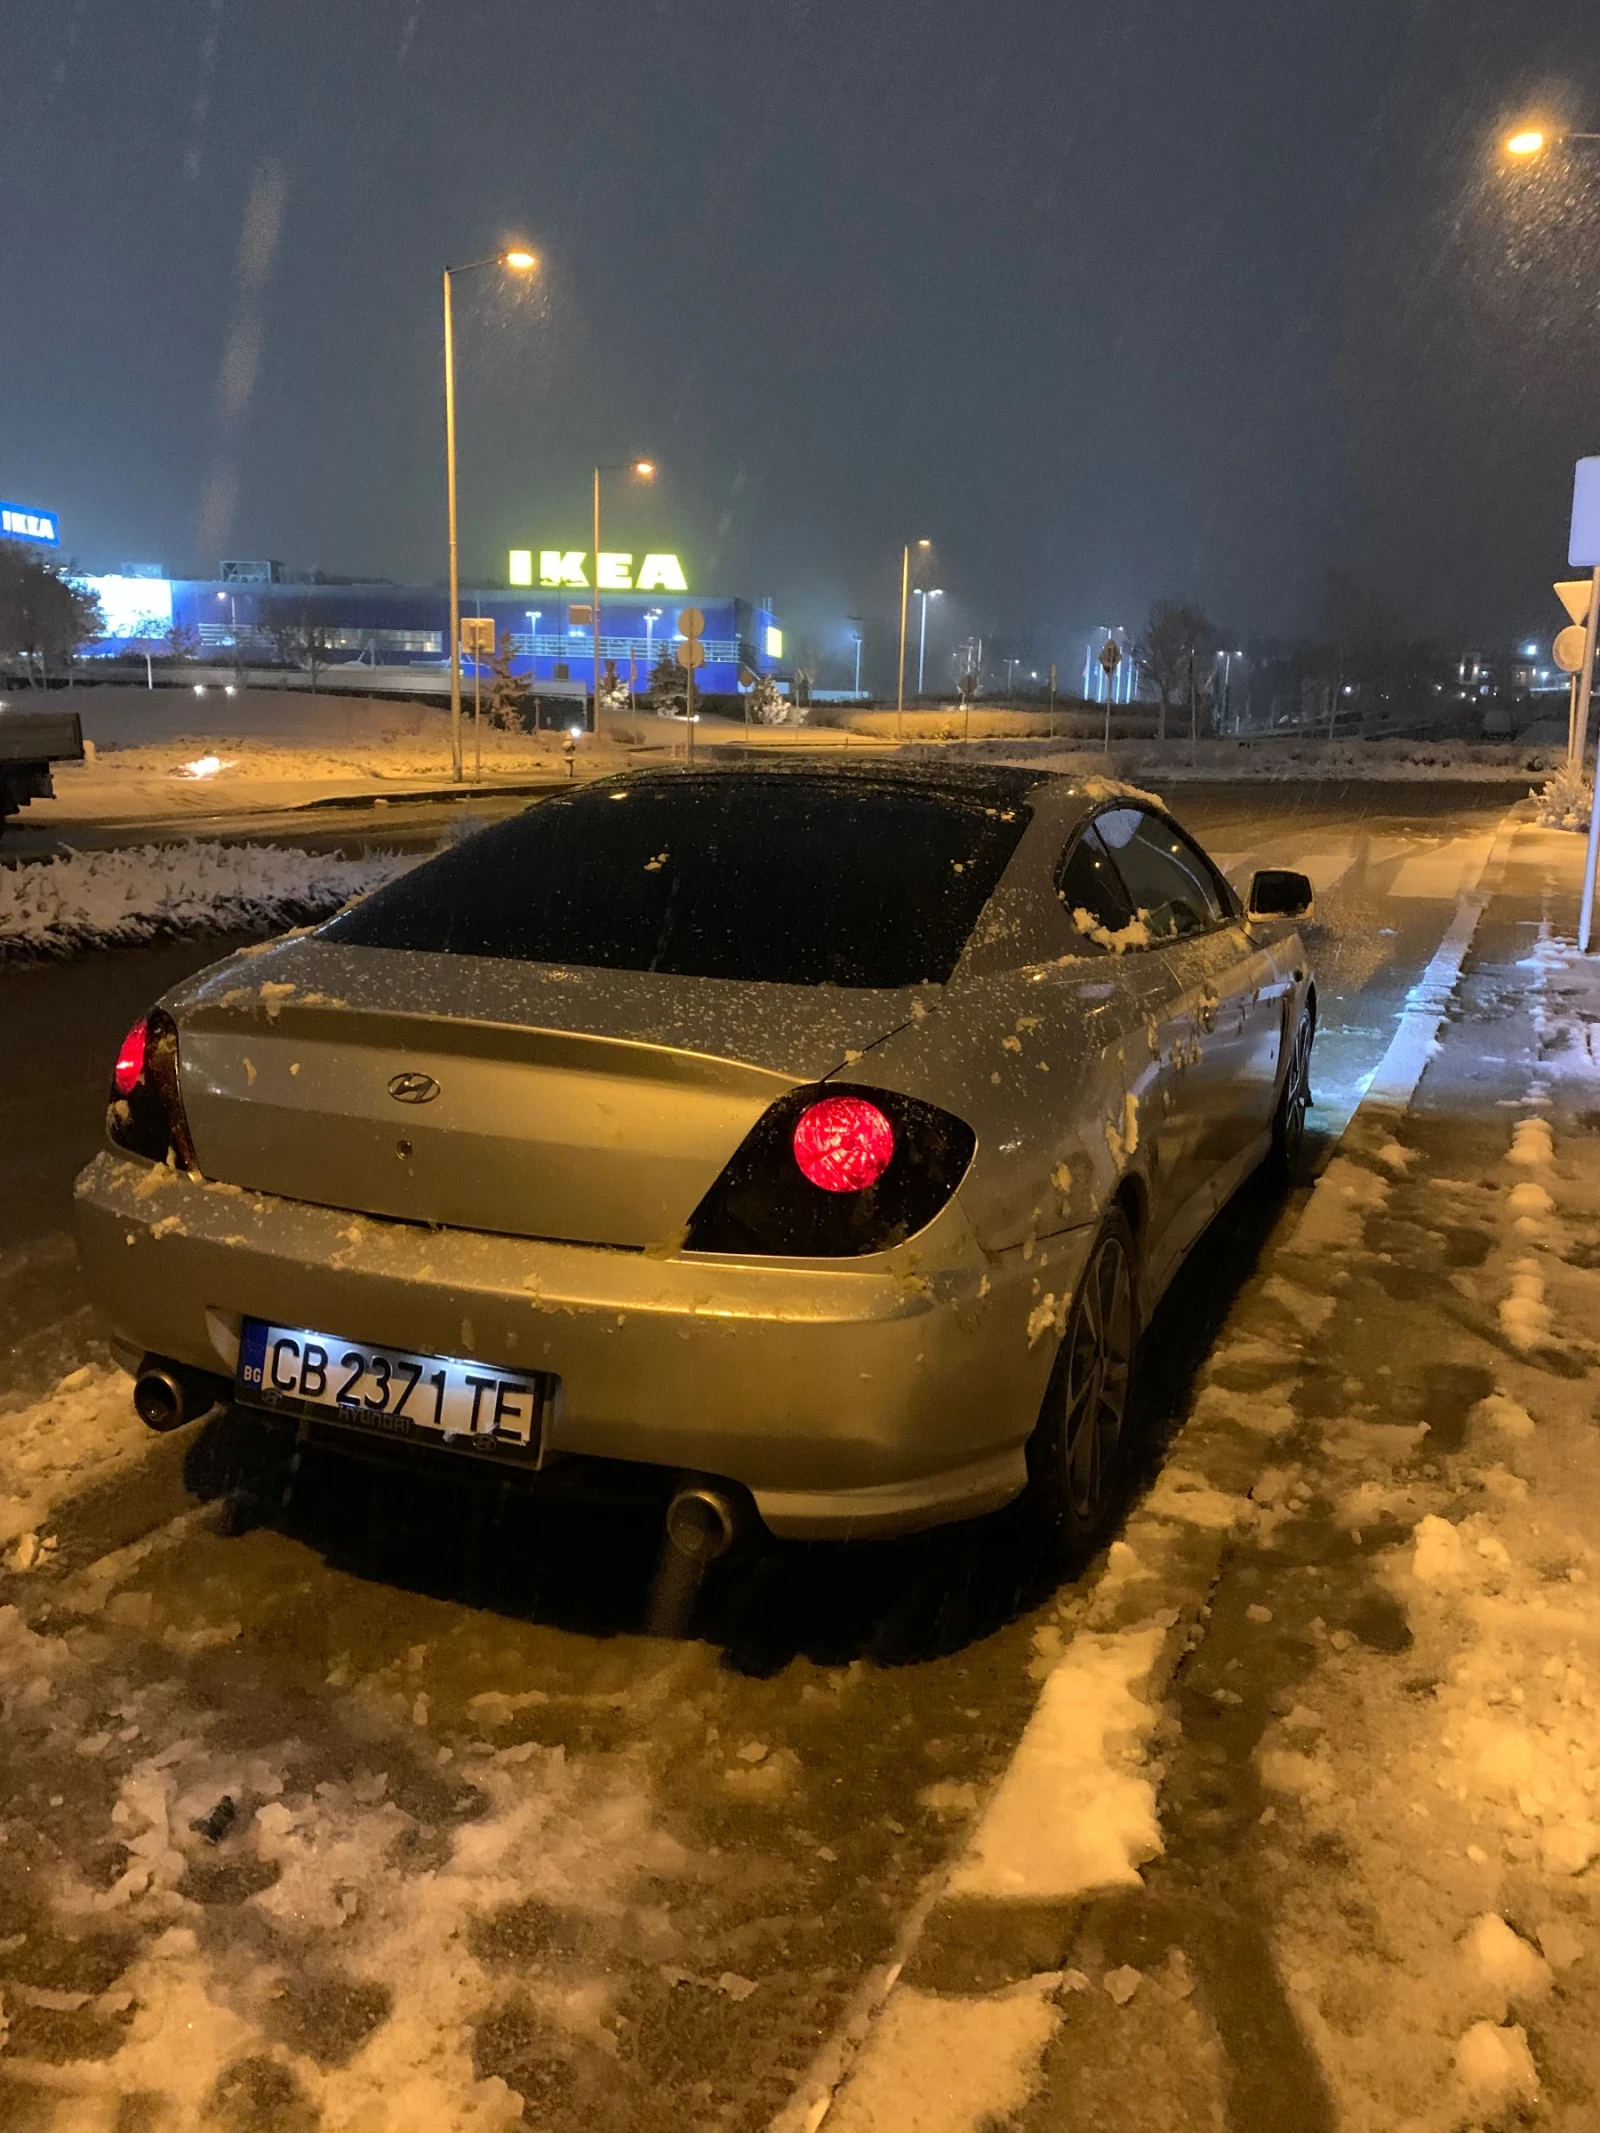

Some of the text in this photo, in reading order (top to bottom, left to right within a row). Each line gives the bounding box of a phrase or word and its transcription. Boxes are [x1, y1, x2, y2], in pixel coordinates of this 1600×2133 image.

[509, 550, 688, 590] IKEA
[243, 1364, 262, 1384] BG
[271, 1338, 530, 1441] CB 2371 TE
[338, 1405, 411, 1434] HYUNDAI
